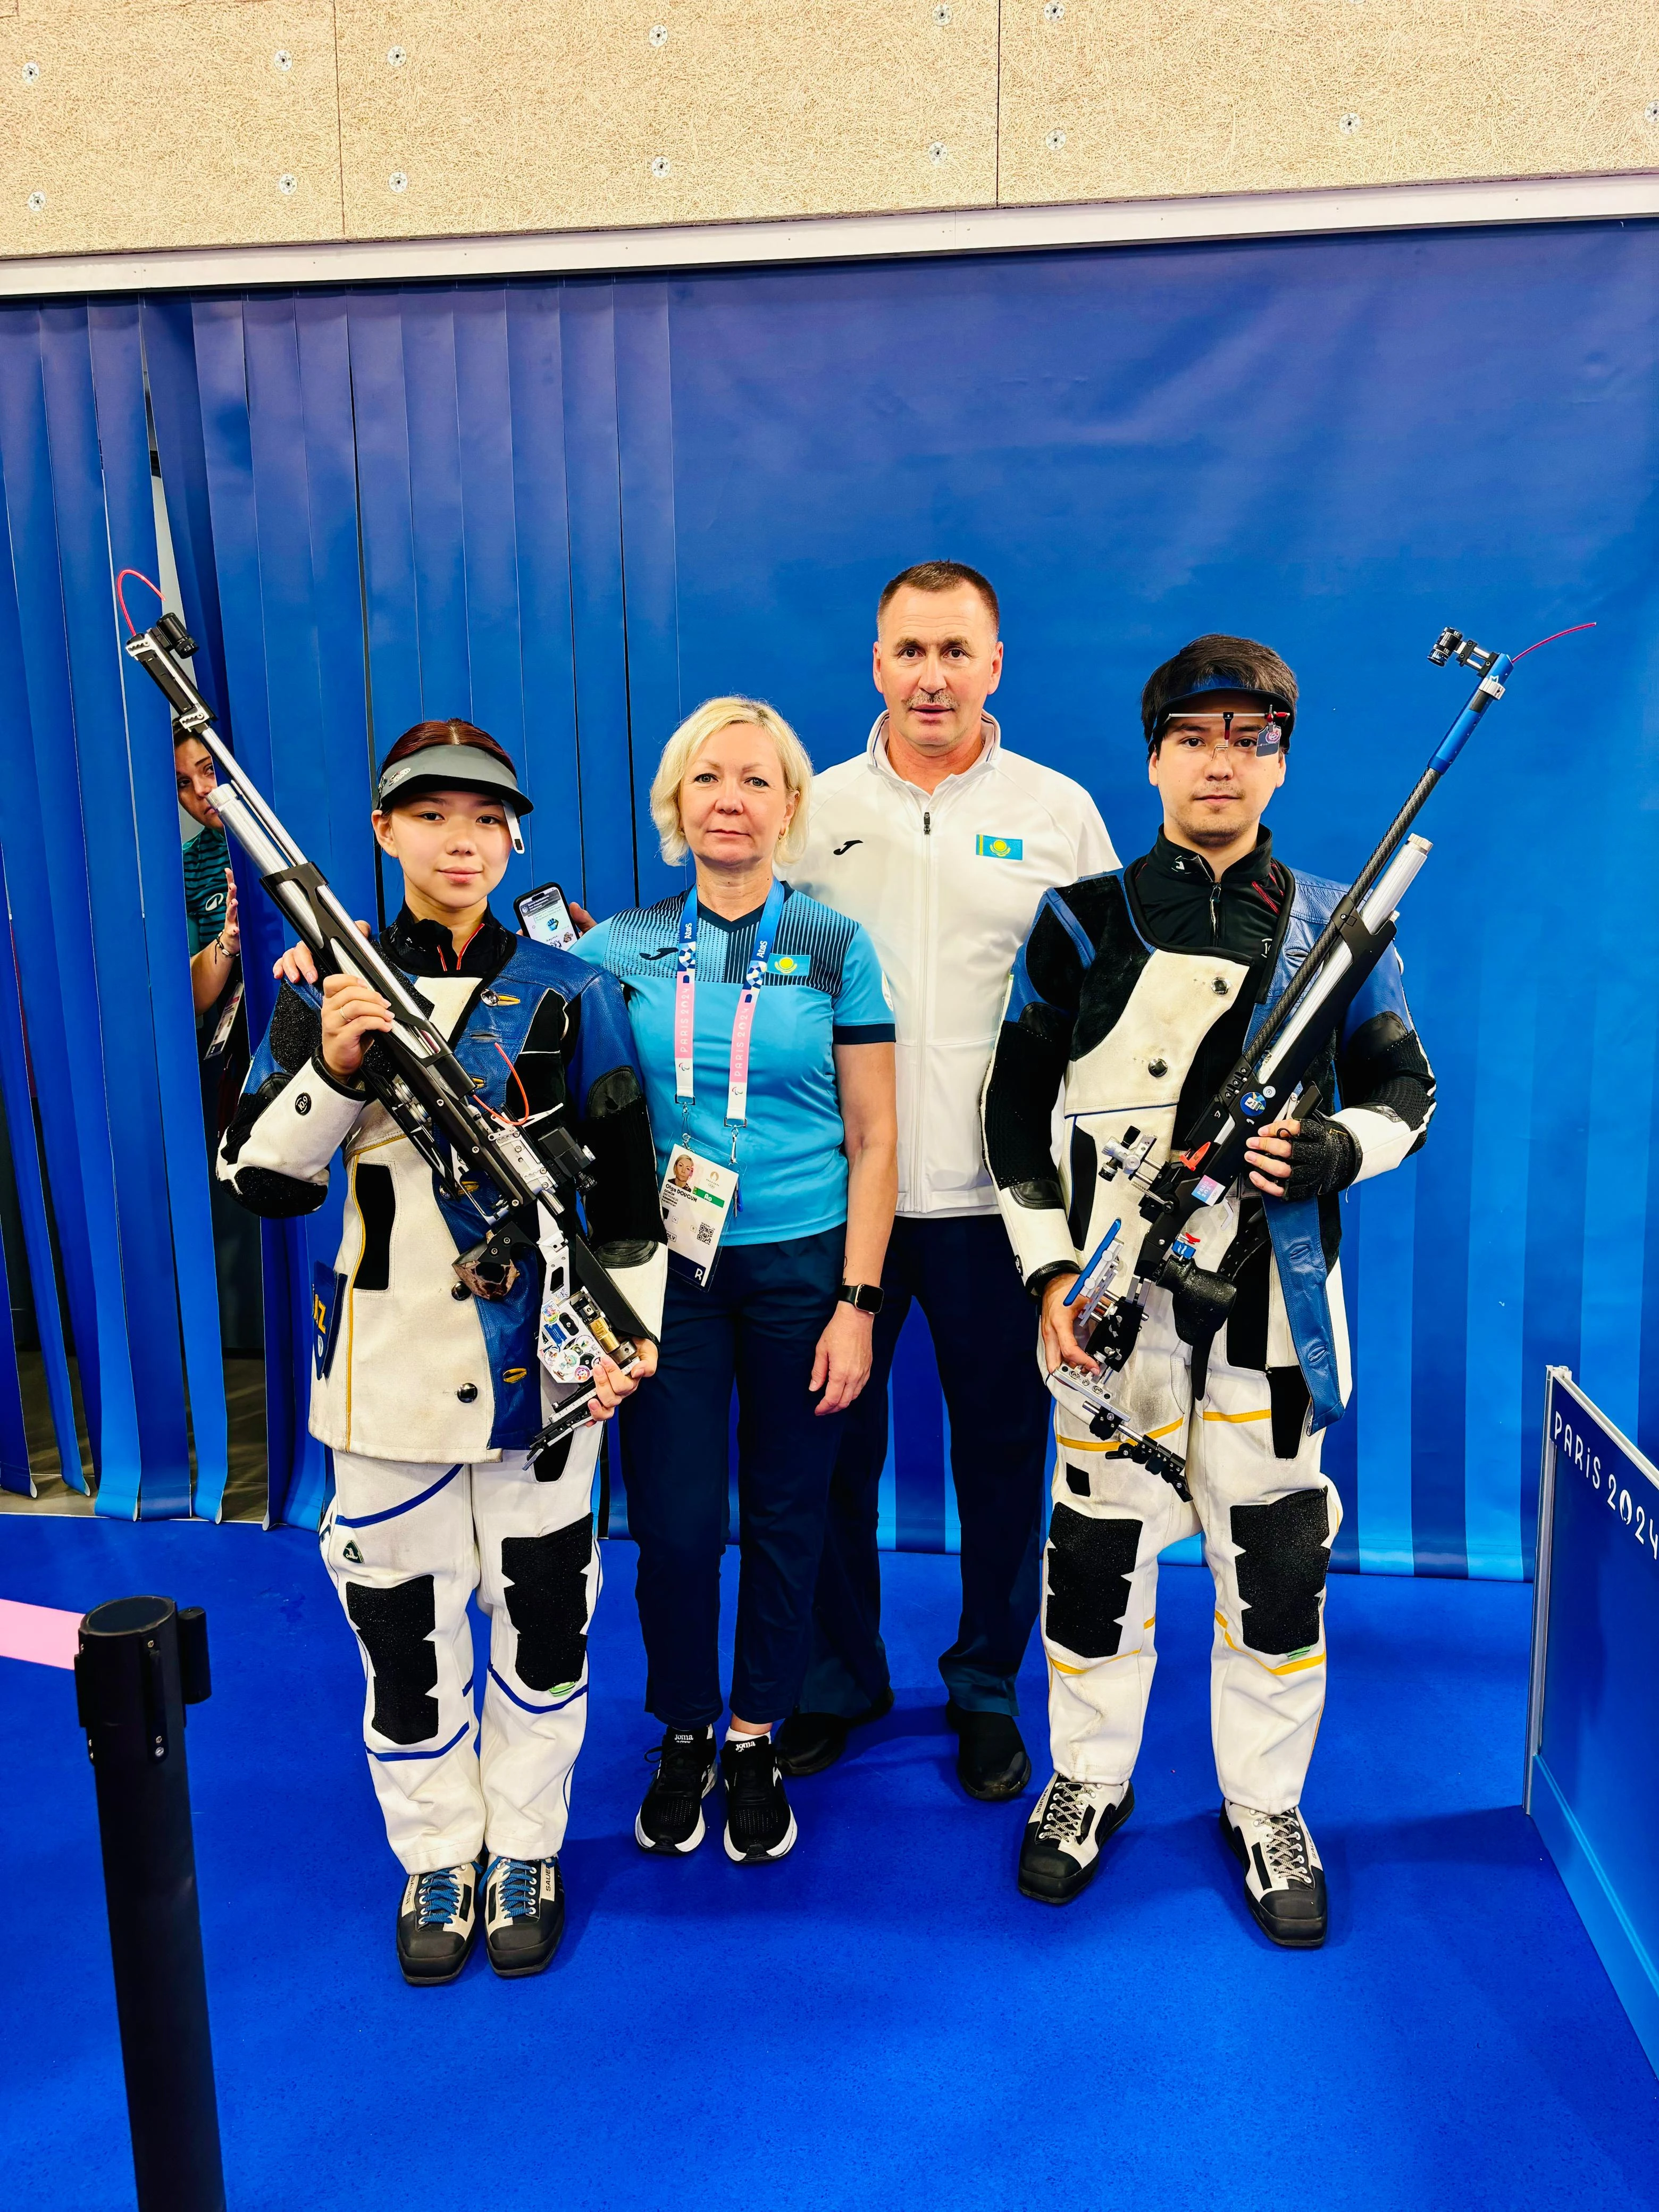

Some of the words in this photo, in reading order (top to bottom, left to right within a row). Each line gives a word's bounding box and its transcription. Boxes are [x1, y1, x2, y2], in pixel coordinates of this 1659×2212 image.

[684, 922, 692, 939] Atos
[757, 940, 767, 959] Atos
[681, 987, 690, 1015] 2024
[738, 1007, 749, 1038] 2024
[680, 1018, 689, 1053] PARIS
[734, 1042, 744, 1077] PARIS
[298, 1095, 308, 1110] 10.9
[665, 1184, 676, 1193] Olga
[1196, 1180, 1209, 1195] PARIS
[1201, 1184, 1213, 1198] 2024
[1607, 1473, 1658, 1560] 2024
[405, 1875, 415, 1905] SAUER
